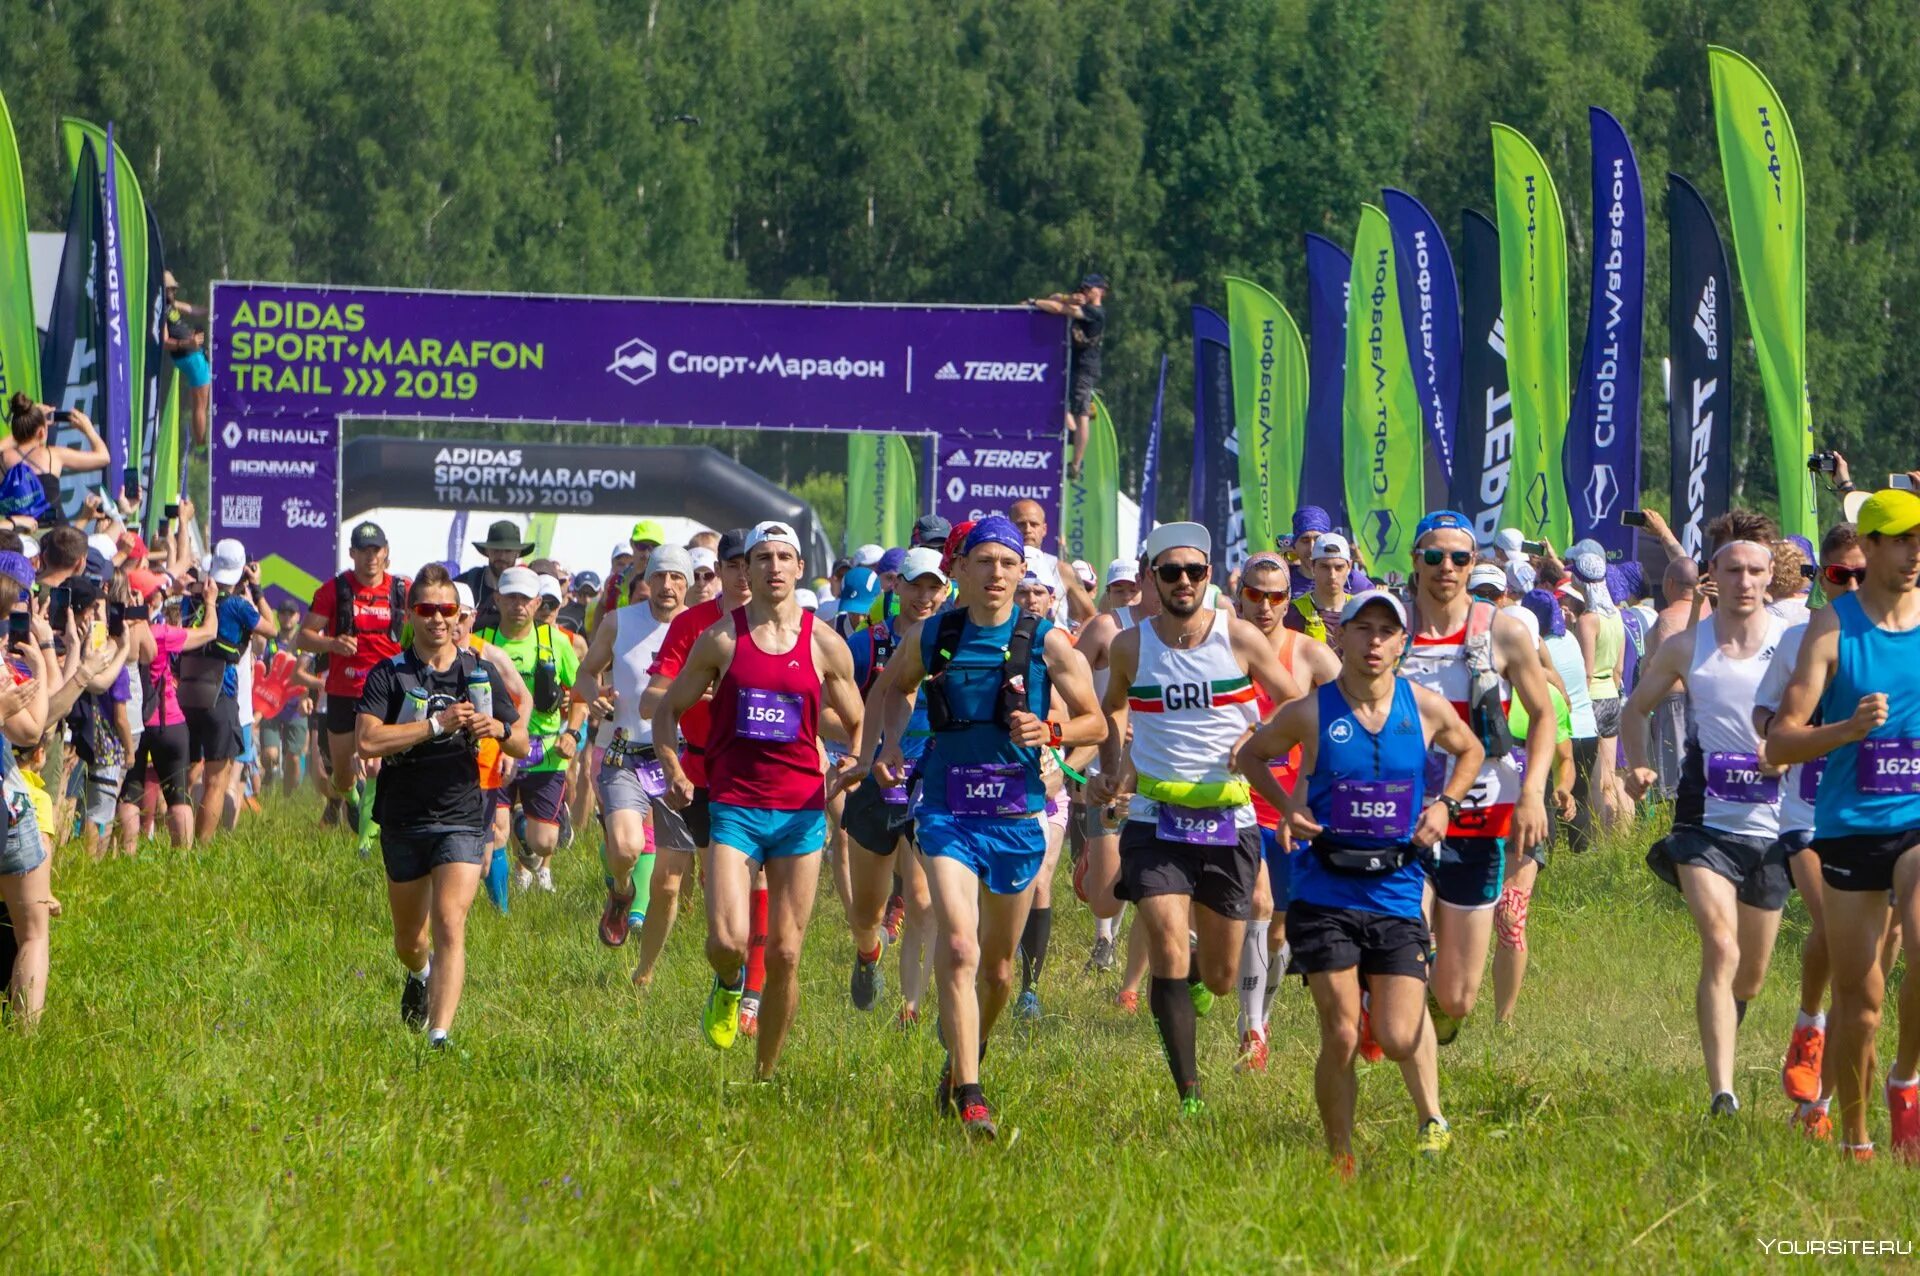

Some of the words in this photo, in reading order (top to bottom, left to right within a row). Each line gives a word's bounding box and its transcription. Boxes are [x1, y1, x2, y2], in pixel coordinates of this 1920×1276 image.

[231, 299, 365, 332] ADIDAS
[963, 360, 1049, 382] TERREX
[230, 364, 331, 394] TRAIL
[394, 370, 478, 400] 2019
[247, 428, 329, 445] RENAULT
[434, 448, 523, 467] ADIDAS
[973, 448, 1053, 470] TERREX
[231, 459, 316, 475] IRONMAN
[434, 485, 500, 504] TRAIL
[541, 488, 594, 507] 2019
[970, 483, 1052, 500] RENAULT
[286, 505, 328, 529] Bite
[1165, 681, 1210, 711] GRI
[747, 706, 786, 724] 1562
[1876, 757, 1920, 775] 1629
[1725, 768, 1763, 785] 1702
[965, 782, 1006, 799] 1417
[1350, 801, 1397, 818] 1582
[1175, 816, 1219, 834] 1249
